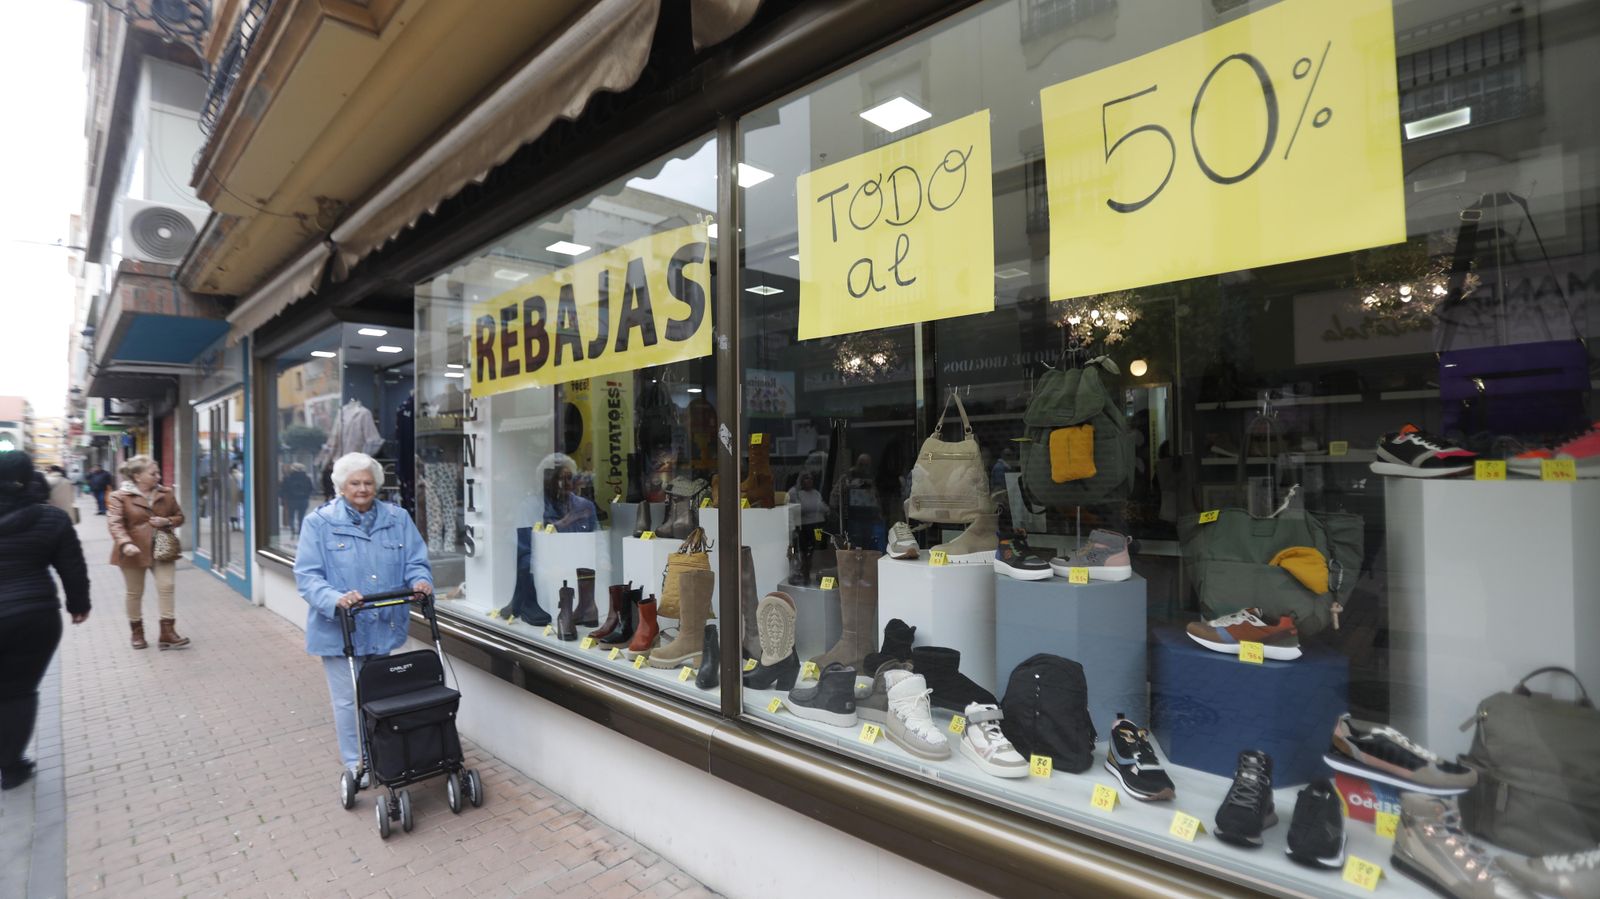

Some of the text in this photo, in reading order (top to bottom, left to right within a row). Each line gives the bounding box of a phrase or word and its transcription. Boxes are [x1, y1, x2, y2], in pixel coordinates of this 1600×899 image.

[1102, 39, 1333, 214] 50%
[816, 144, 974, 244] TODO
[474, 241, 709, 384] REBAJAS
[846, 232, 917, 299] al
